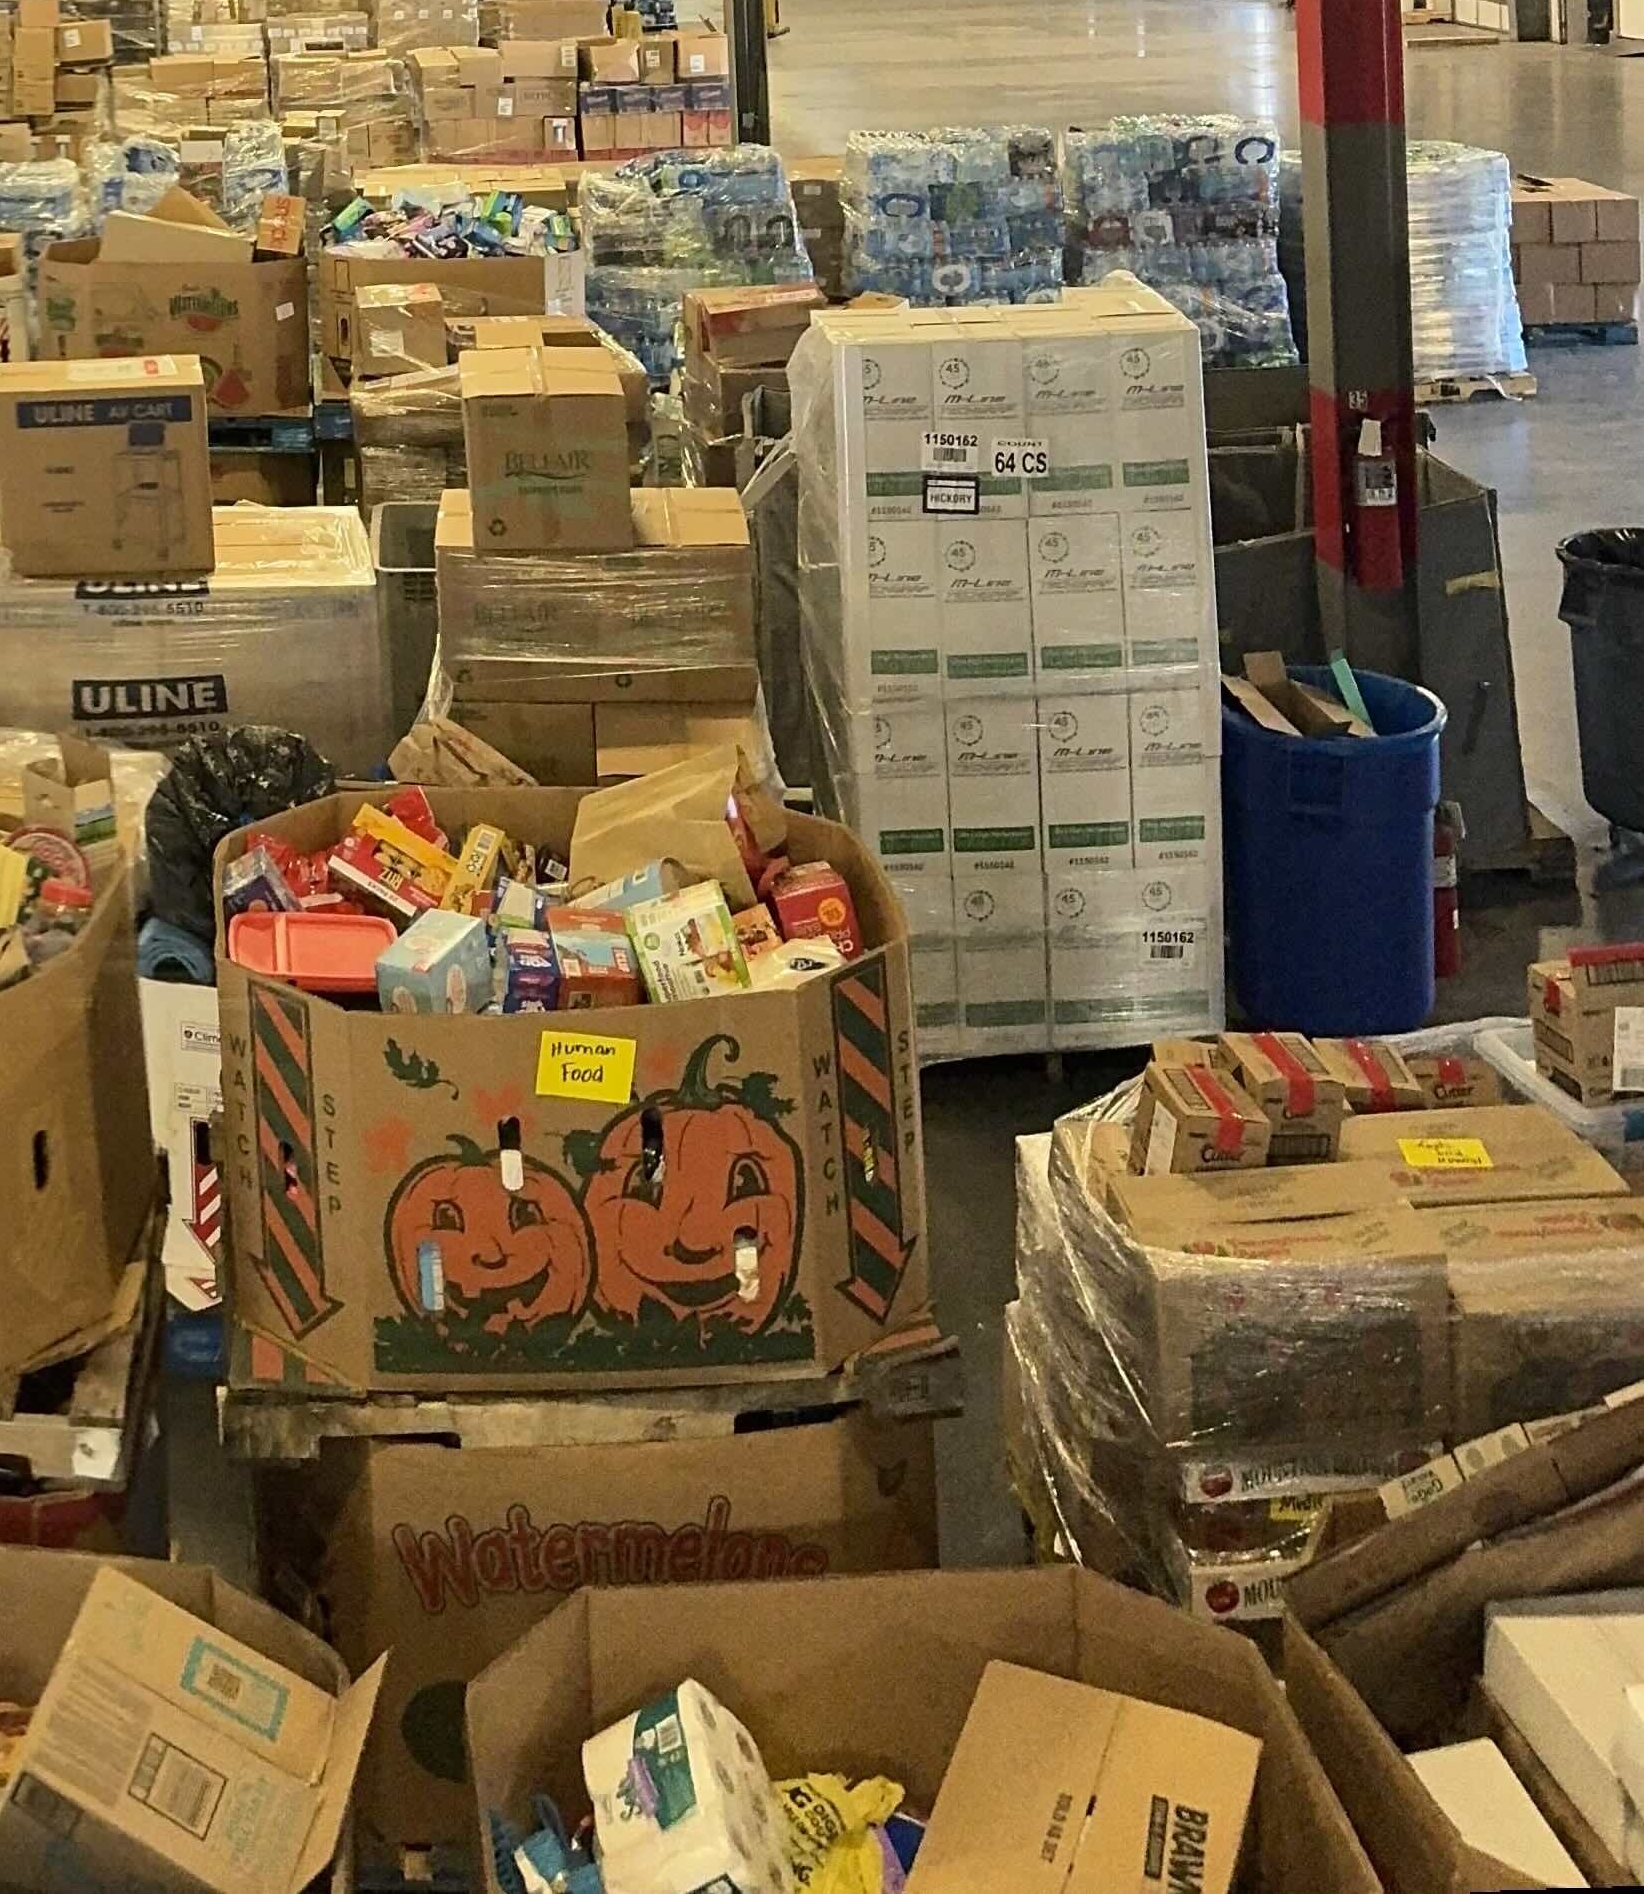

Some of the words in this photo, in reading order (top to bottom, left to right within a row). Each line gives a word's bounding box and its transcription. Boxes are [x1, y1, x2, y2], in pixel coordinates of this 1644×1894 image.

[34, 404, 95, 423] ULINE
[923, 432, 978, 447] 1150162
[995, 452, 1016, 474] 64
[1022, 452, 1047, 474] CS
[930, 493, 972, 504] HICKORY
[81, 681, 217, 716] ULINE
[379, 867, 403, 892] RITZ
[1141, 931, 1194, 945] 1150162
[551, 1041, 616, 1058] Human
[561, 1062, 604, 1083] Food
[897, 1030, 916, 1153] STEP
[230, 1033, 254, 1190] WATCH
[812, 1050, 840, 1216] WATCH
[322, 1093, 343, 1215] STEP
